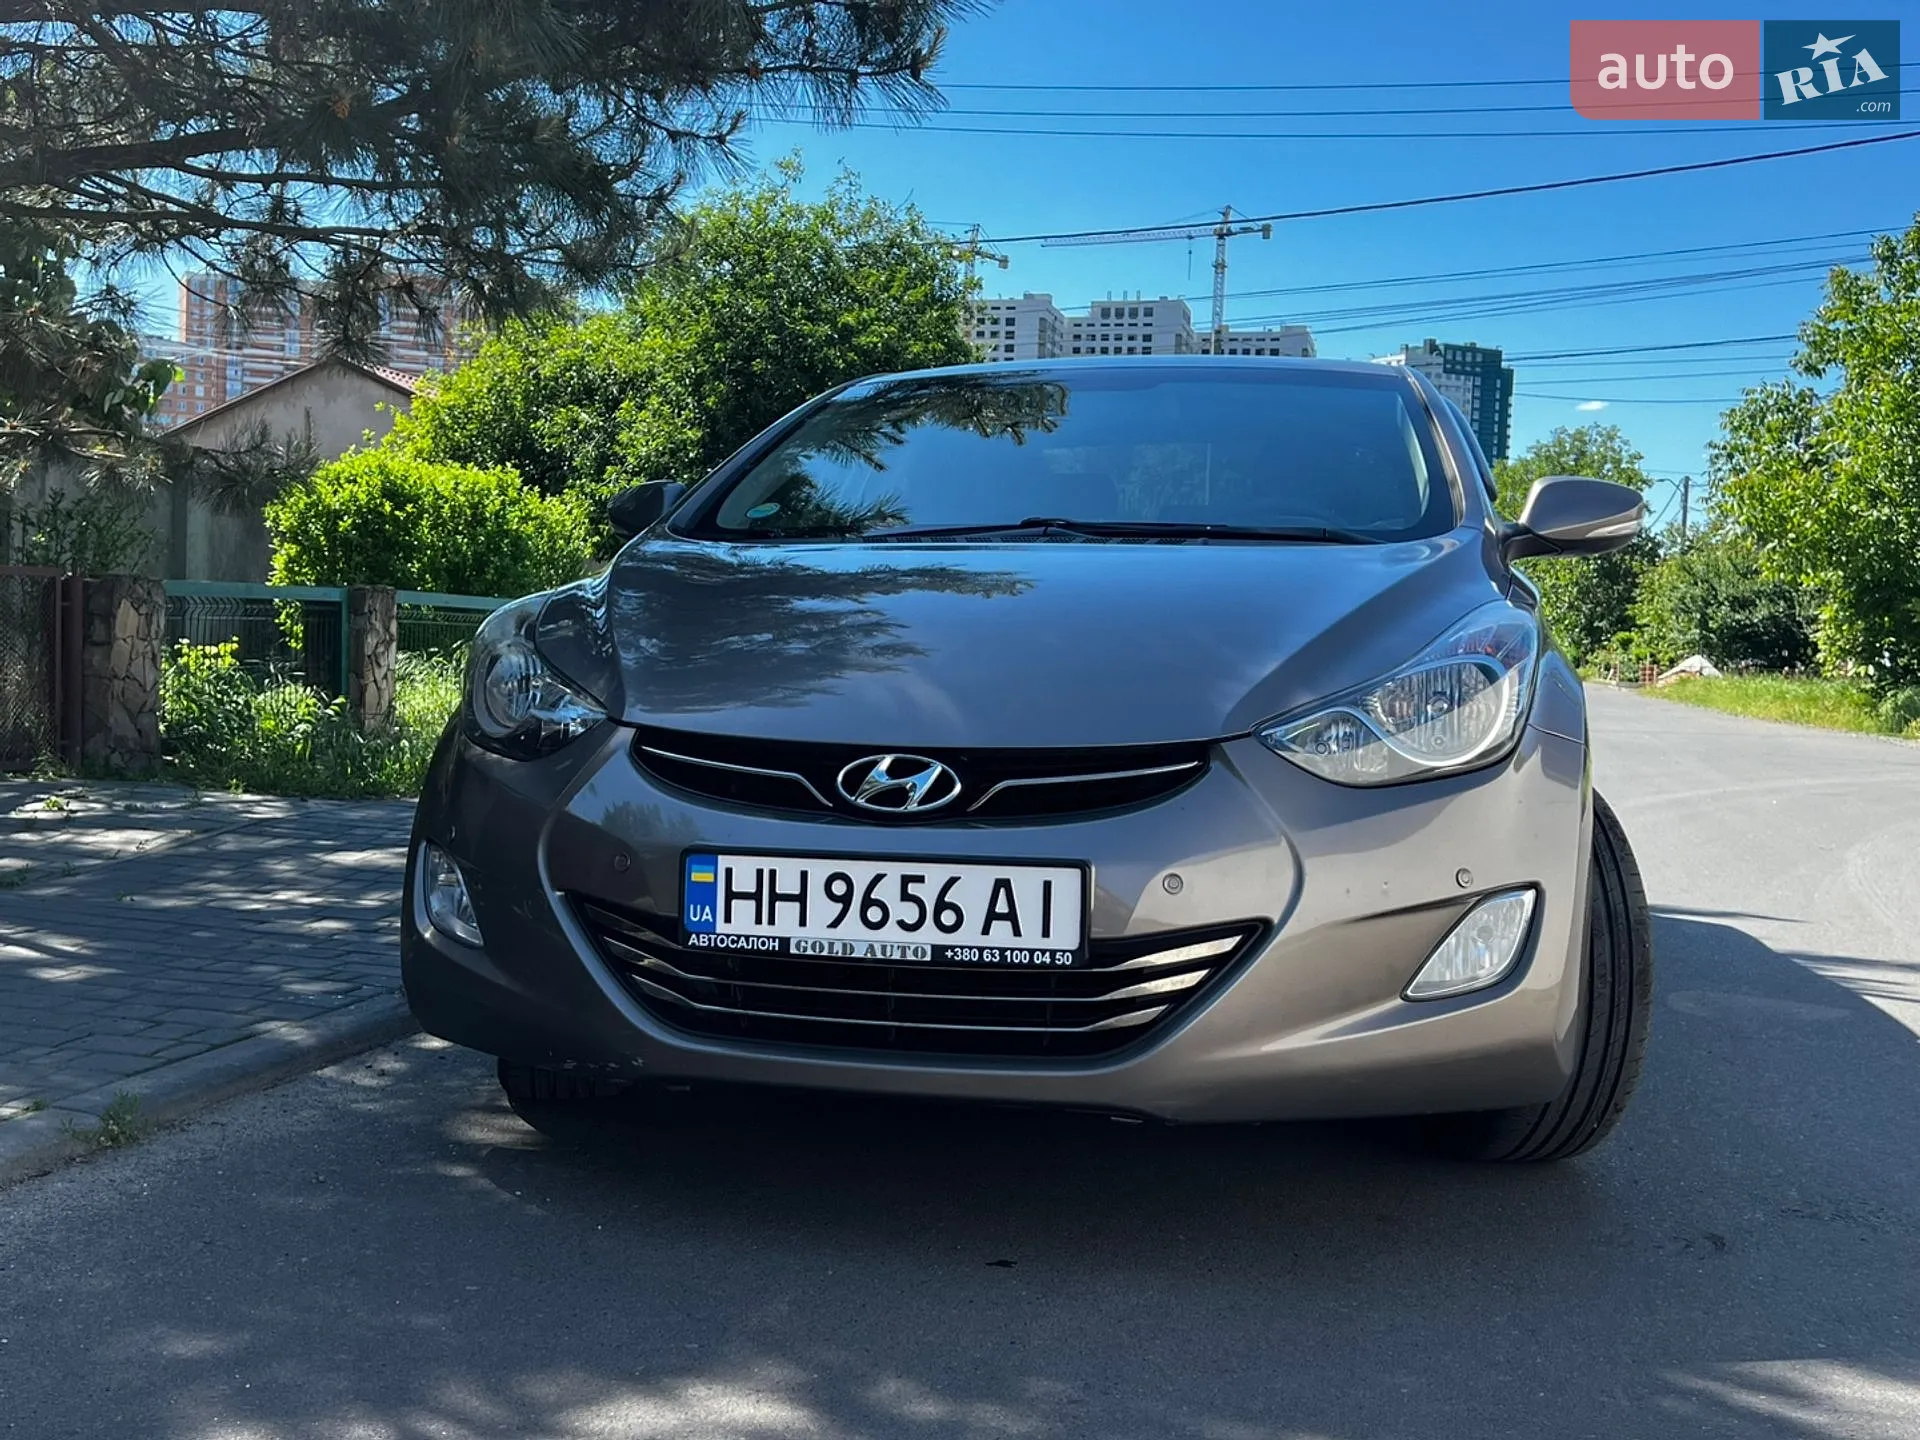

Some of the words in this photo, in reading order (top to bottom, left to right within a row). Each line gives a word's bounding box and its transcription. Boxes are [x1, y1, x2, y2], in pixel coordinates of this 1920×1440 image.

[723, 866, 809, 928] HH
[823, 870, 965, 935] 9656
[980, 877, 1053, 939] AI
[689, 904, 713, 923] UA
[687, 933, 779, 951] АВТОСАЛОН
[794, 940, 856, 957] GOLD
[863, 943, 928, 960] AUTO
[944, 948, 979, 962] +380
[982, 949, 1000, 963] 63
[1004, 950, 1030, 964] 100
[1033, 951, 1052, 965] 04
[1054, 951, 1073, 966] 50
